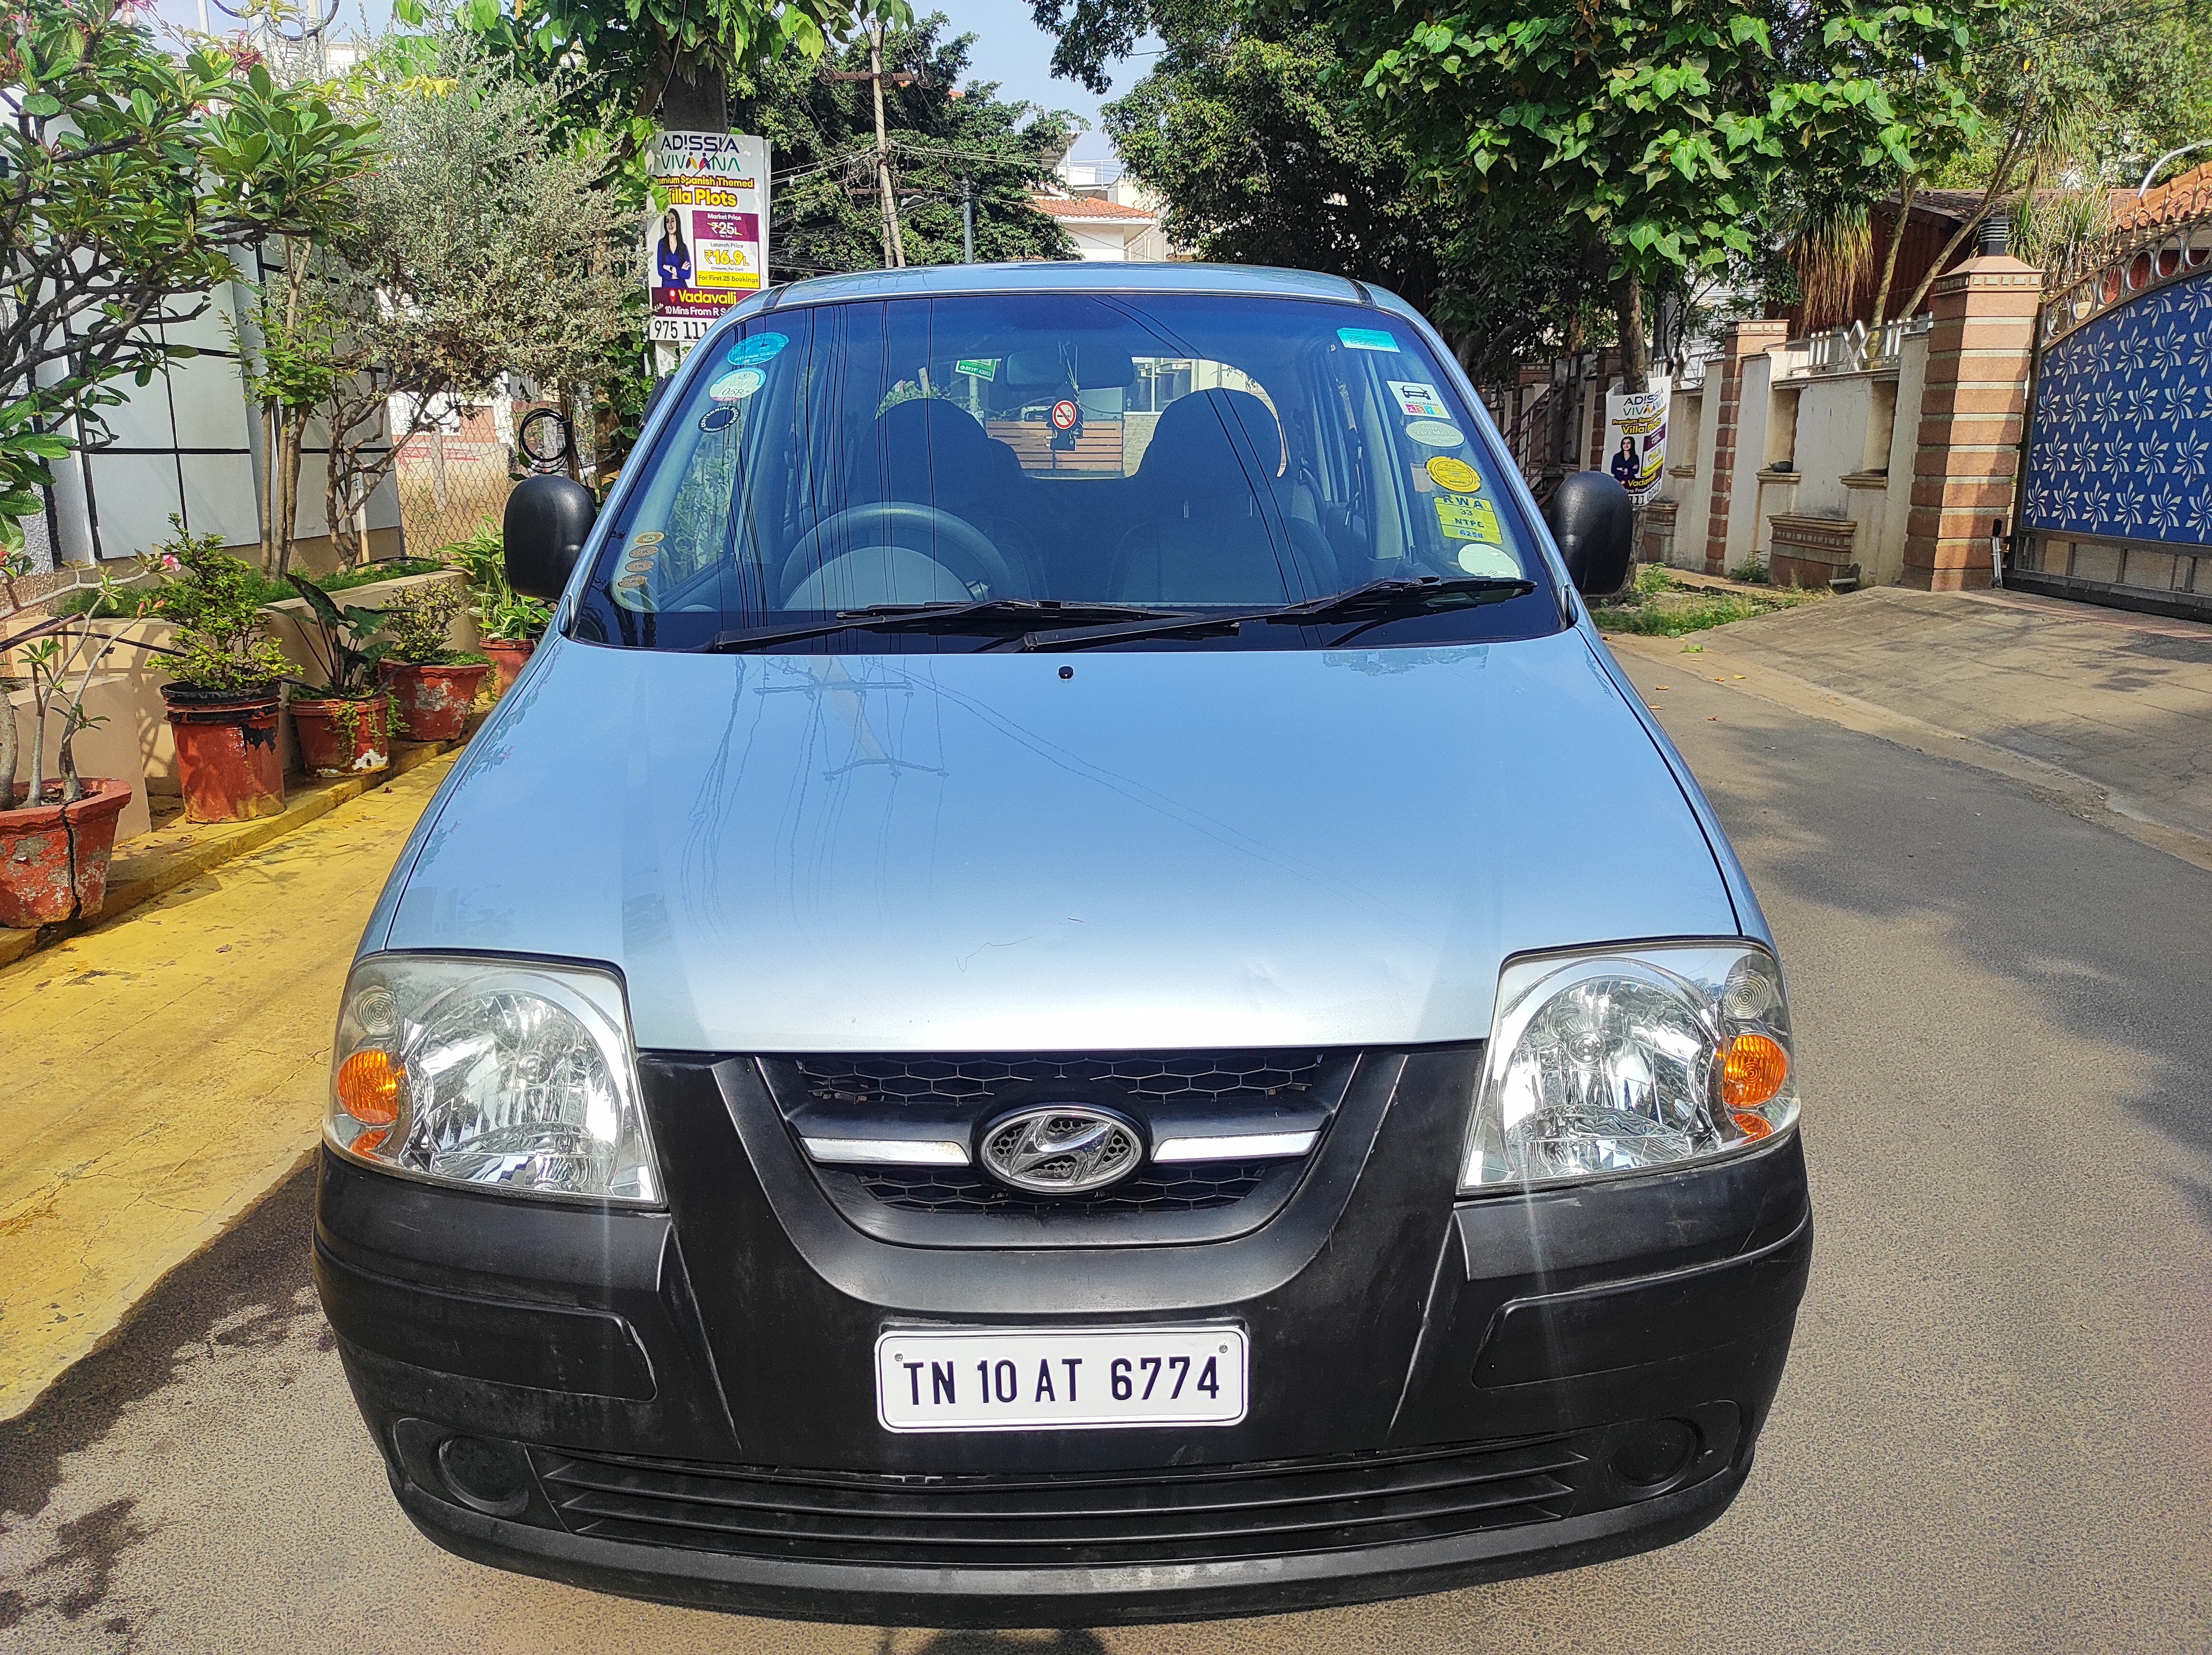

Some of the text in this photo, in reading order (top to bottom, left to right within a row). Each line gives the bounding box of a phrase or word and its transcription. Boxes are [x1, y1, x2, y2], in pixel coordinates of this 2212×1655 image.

[680, 175, 716, 186] Spanish
[717, 177, 754, 188] Themed
[669, 188, 737, 206] illa Plots
[678, 288, 737, 305] Vadavalli
[665, 306, 672, 314] 10
[673, 306, 689, 316] Mins
[690, 306, 712, 316] From
[655, 320, 678, 339] 975
[1622, 425, 1645, 435] Villa
[1454, 518, 1485, 528] NTPC
[903, 1355, 1220, 1405] TN 10 AT 6774
